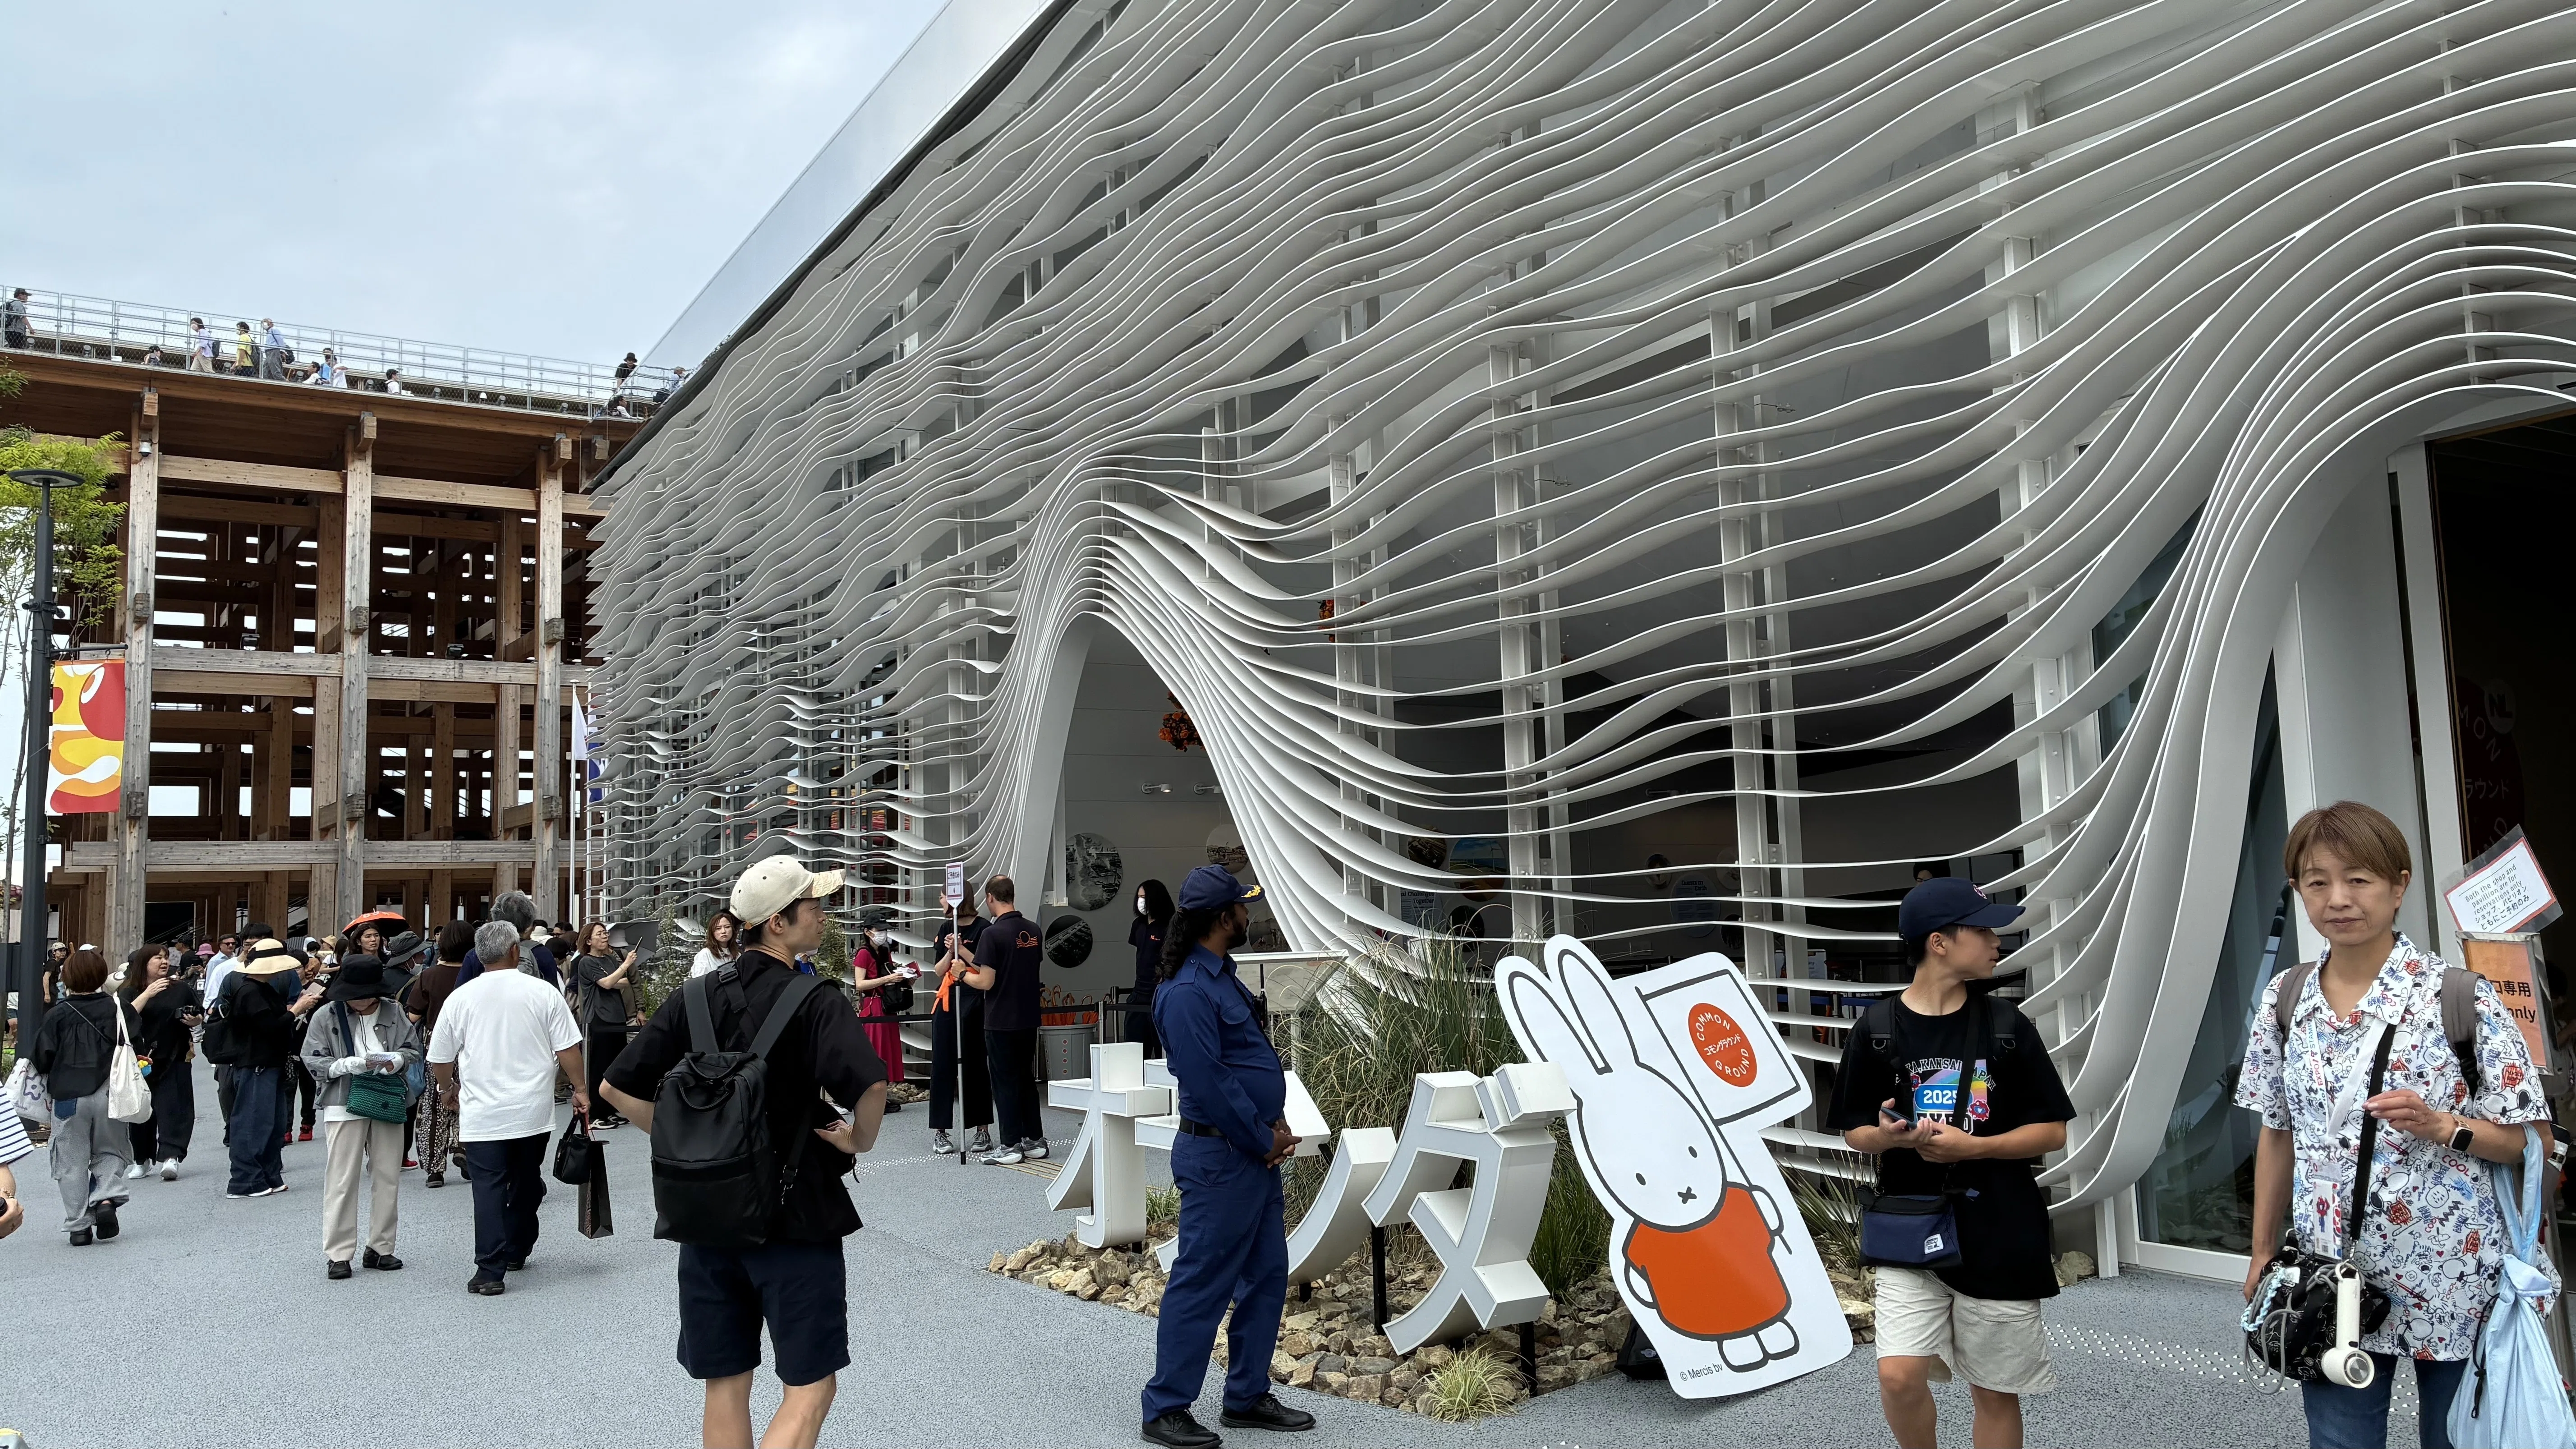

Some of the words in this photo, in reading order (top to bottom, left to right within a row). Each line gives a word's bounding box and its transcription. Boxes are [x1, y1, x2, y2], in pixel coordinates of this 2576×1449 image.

[2465, 890, 2480, 902] Both
[2480, 882, 2492, 892] the
[2493, 874, 2506, 886] shop
[2507, 864, 2517, 876] and
[2472, 888, 2499, 908] pavillion
[2500, 881, 2508, 890] are
[2509, 874, 2517, 884] for
[2474, 890, 2510, 915] reservations
[2511, 880, 2522, 892] only
[2489, 980, 2531, 997] 口専用
[1696, 1012, 1731, 1041] COMMON
[1703, 1033, 1742, 1056] コモングラウンド
[1715, 1048, 1750, 1078] GROUND
[2442, 1155, 2470, 1177] COOL
[1045, 1041, 1577, 1356] オンダ
[1687, 1365, 1714, 1380] Mercis
[1712, 1363, 1723, 1372] bv
